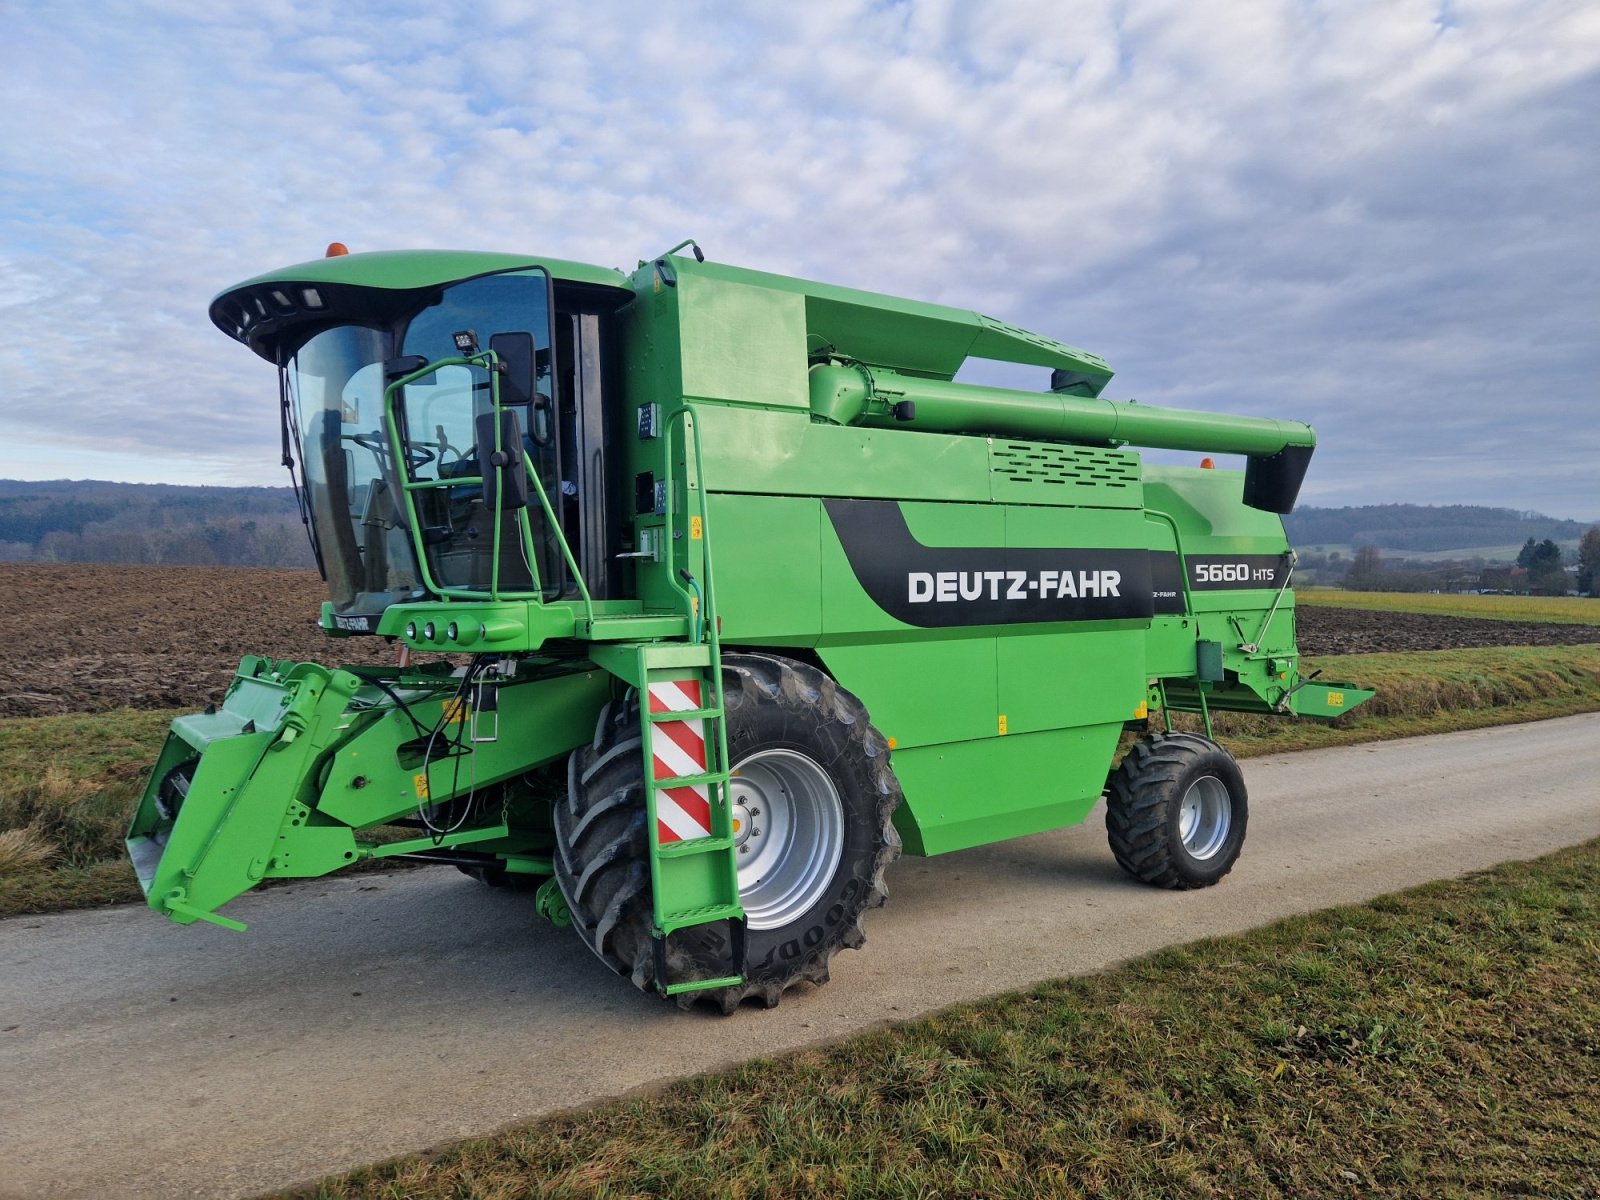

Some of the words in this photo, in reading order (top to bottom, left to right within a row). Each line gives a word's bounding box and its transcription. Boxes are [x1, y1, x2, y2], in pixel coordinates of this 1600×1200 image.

[1195, 564, 1249, 582] 5660
[1253, 569, 1275, 581] HTS
[908, 570, 1121, 603] DEUTZ-FAHR
